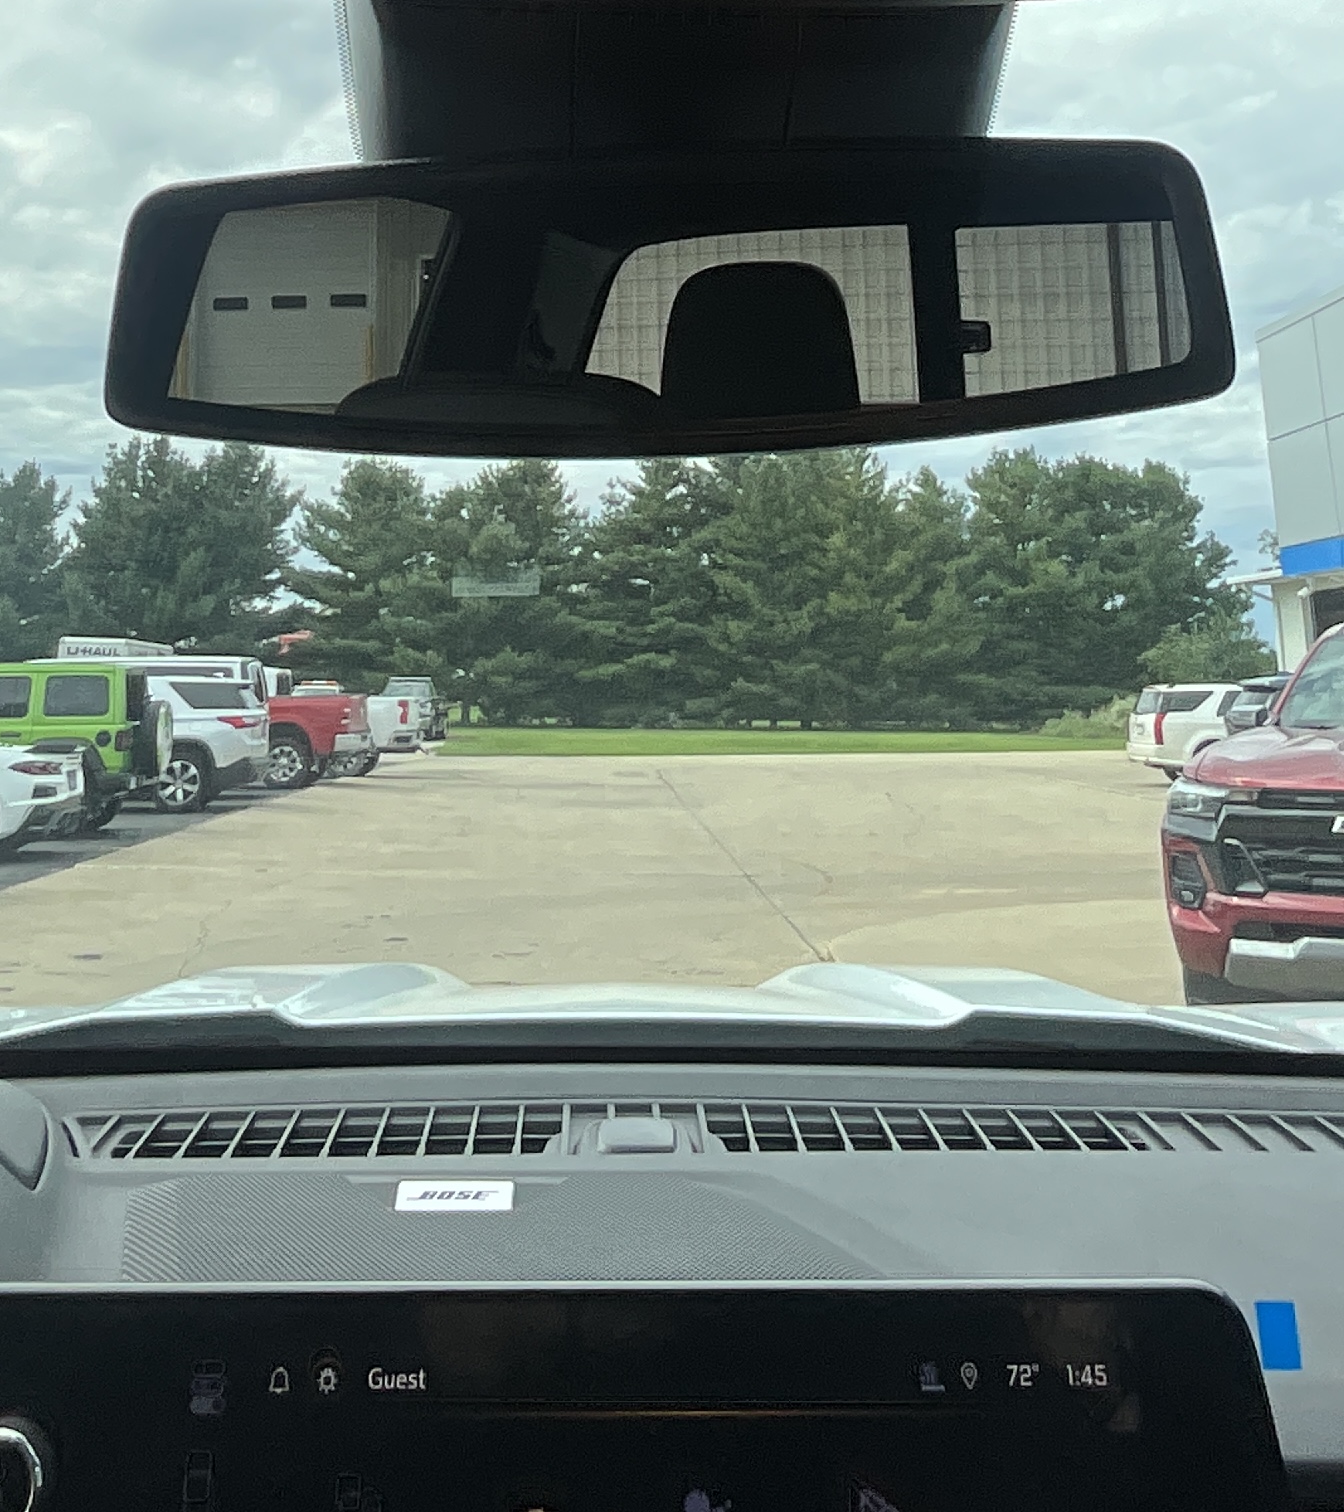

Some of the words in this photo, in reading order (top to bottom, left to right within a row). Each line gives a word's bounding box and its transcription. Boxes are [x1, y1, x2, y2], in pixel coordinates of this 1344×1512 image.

[407, 1190, 498, 1201] BOSE
[368, 1367, 427, 1390] Guest
[1006, 1363, 1039, 1387] 72°
[1066, 1364, 1106, 1387] 1:45
